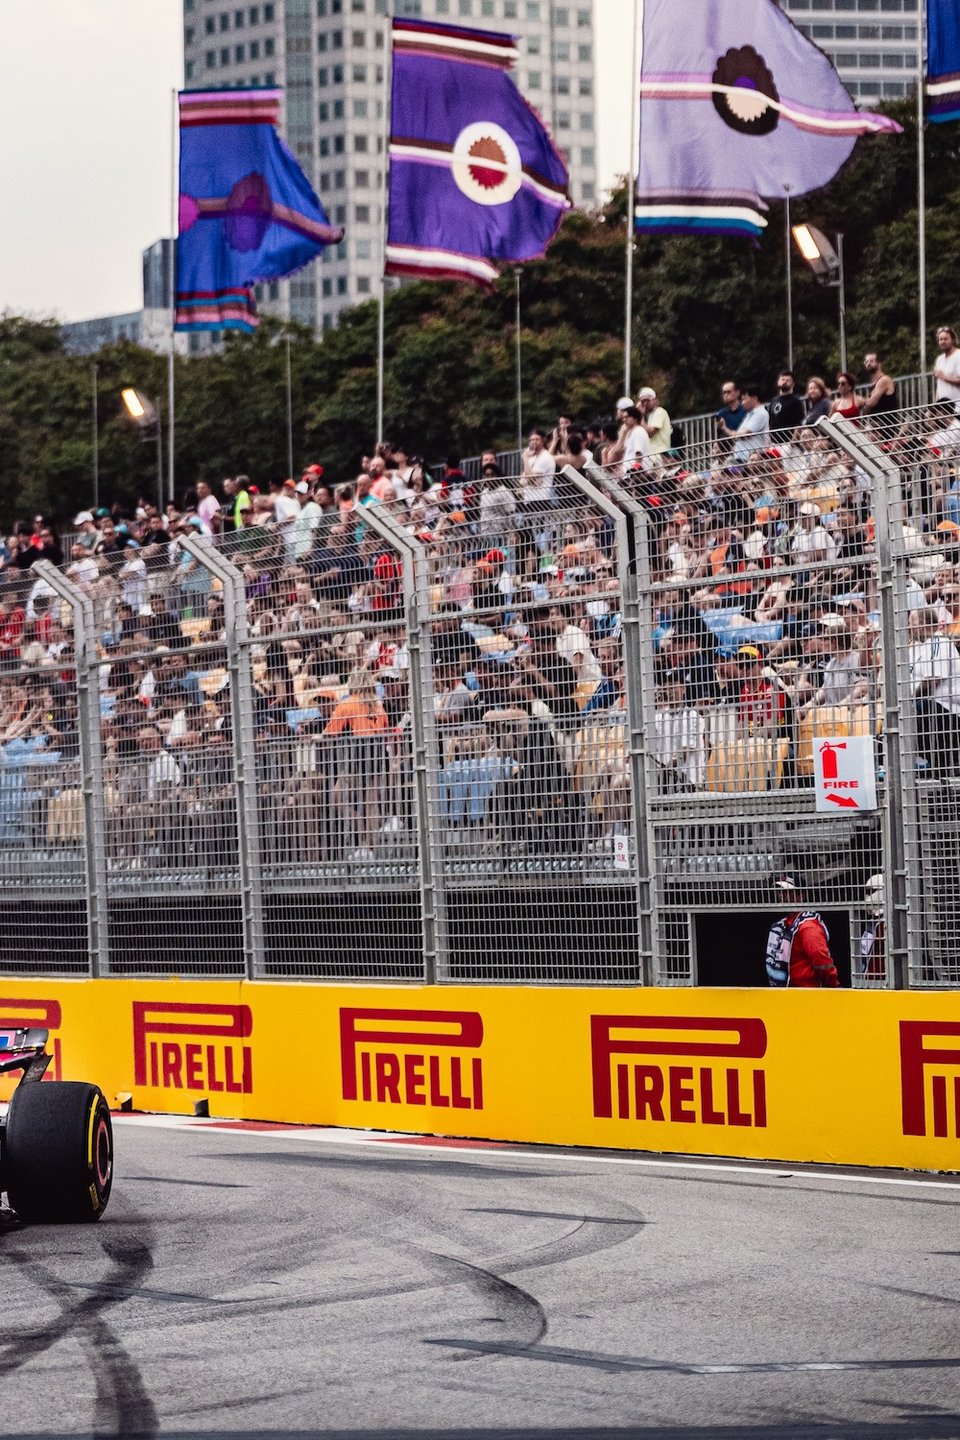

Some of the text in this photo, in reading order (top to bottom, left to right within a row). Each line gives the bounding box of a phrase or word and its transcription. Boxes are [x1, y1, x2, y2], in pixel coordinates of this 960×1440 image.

[823, 780, 859, 789] FIRE
[133, 1001, 253, 1094] PIRELLI
[339, 1007, 483, 1110] PIRELLI
[590, 1015, 767, 1127] PIRELLI
